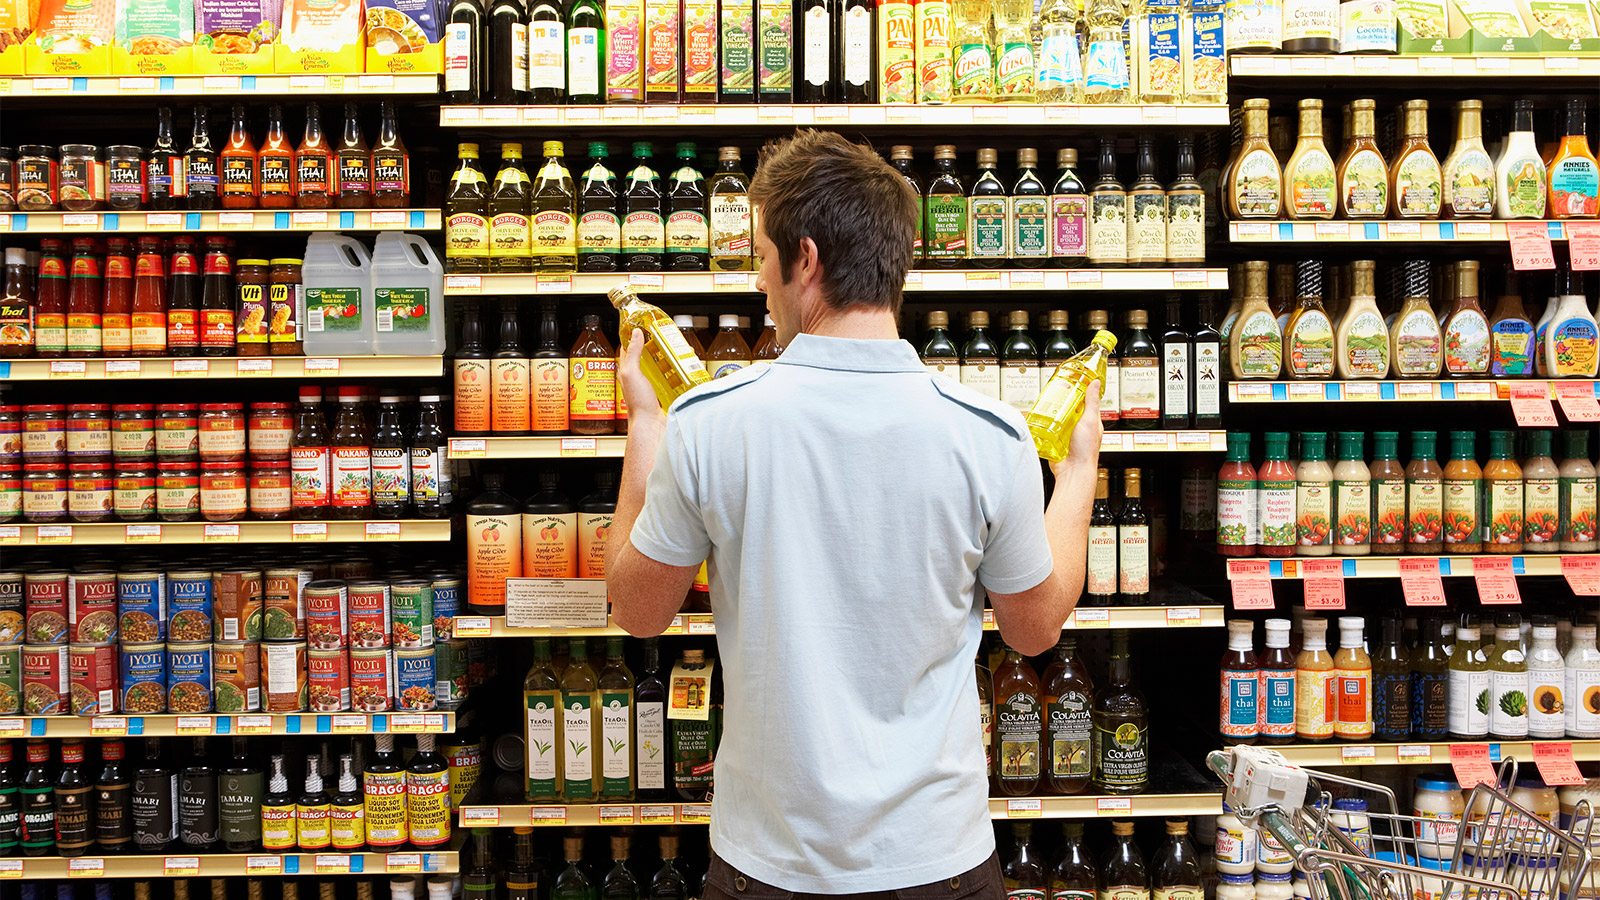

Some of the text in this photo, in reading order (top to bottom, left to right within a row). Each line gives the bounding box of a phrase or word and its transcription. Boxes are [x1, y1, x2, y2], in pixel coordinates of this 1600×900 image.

[613, 38, 634, 46] WHITE
[956, 51, 990, 78] Crisco
[1000, 52, 1031, 77] Crisco
[191, 162, 214, 172] THAI
[342, 167, 368, 178] THAI
[376, 166, 402, 178] THAI
[110, 169, 138, 180] THAI
[224, 168, 251, 180] THAI
[261, 168, 288, 180] THAI
[298, 168, 324, 179] THAI
[714, 206, 748, 214] BERIO
[452, 216, 484, 226] BORGES
[494, 216, 526, 226] BORGES
[538, 212, 568, 223] BORGES
[585, 213, 613, 224] BORGES
[629, 213, 657, 224] BORGES
[672, 213, 701, 224] BORGES
[1, 306, 26, 316] Thai
[243, 302, 261, 310] Plum
[271, 302, 286, 310] Plum
[338, 450, 368, 458] NAKANO
[536, 546, 564, 554] Apple Cider
[477, 554, 496, 562] Vinegar
[30, 584, 61, 596] JYOTi
[84, 584, 115, 597] JYOTi
[174, 582, 206, 594] JYOTi
[308, 598, 333, 609] JYOTi
[352, 596, 377, 608] JYOTi
[130, 654, 161, 668] JYOTi
[172, 654, 203, 666] JYOTi
[403, 658, 430, 672] JYOTi
[353, 660, 380, 672] JYOTi
[1236, 698, 1254, 707] thai
[1273, 698, 1291, 706] thai
[1343, 696, 1362, 705] thai
[1000, 711, 1040, 722] COLAVITA
[1051, 710, 1091, 720] COLAVITA
[1108, 749, 1144, 760] COLAVITA
[366, 785, 404, 795] BRAGG
[221, 795, 254, 804] TAMARI
[263, 812, 288, 820] BRAGG
[300, 812, 326, 820] BRAGG
[370, 818, 384, 826] SOJA
